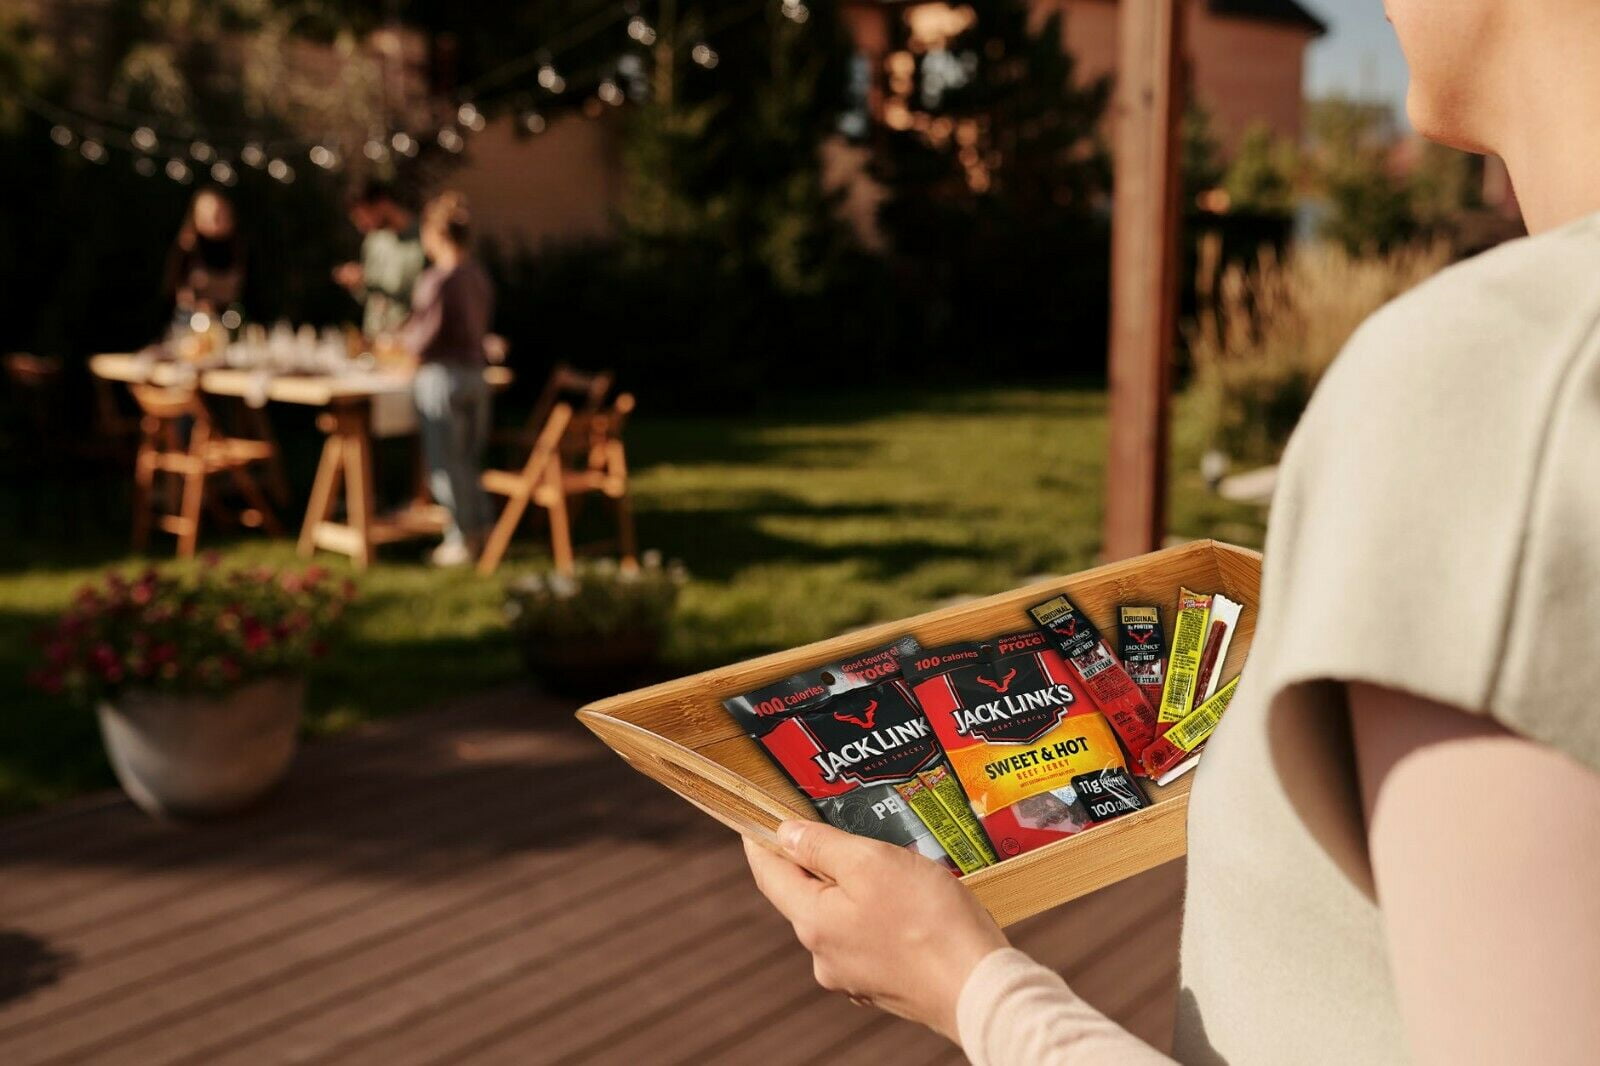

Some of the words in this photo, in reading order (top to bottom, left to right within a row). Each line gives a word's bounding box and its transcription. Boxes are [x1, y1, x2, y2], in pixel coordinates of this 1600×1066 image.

[1040, 604, 1071, 623] ORIGINAL
[1124, 615, 1157, 623] ORIGINAL
[841, 659, 863, 673] Good
[862, 650, 893, 666] Source
[914, 656, 940, 672] 100
[1095, 658, 1113, 671] STEAK
[1142, 676, 1161, 684] STEAK
[752, 696, 786, 718] 100
[952, 701, 1012, 736] JACK
[1003, 684, 1074, 716] LINK'S
[991, 721, 1014, 732] MEAT
[814, 736, 884, 781] JACK
[870, 715, 932, 751] LINK
[984, 749, 1040, 780] SWEET
[1041, 746, 1055, 762] &
[1052, 736, 1089, 758] HOT
[1016, 767, 1040, 781] BEEF
[1042, 759, 1071, 773] JERKY
[1079, 779, 1103, 794] 11g
[1091, 801, 1116, 817] 100
